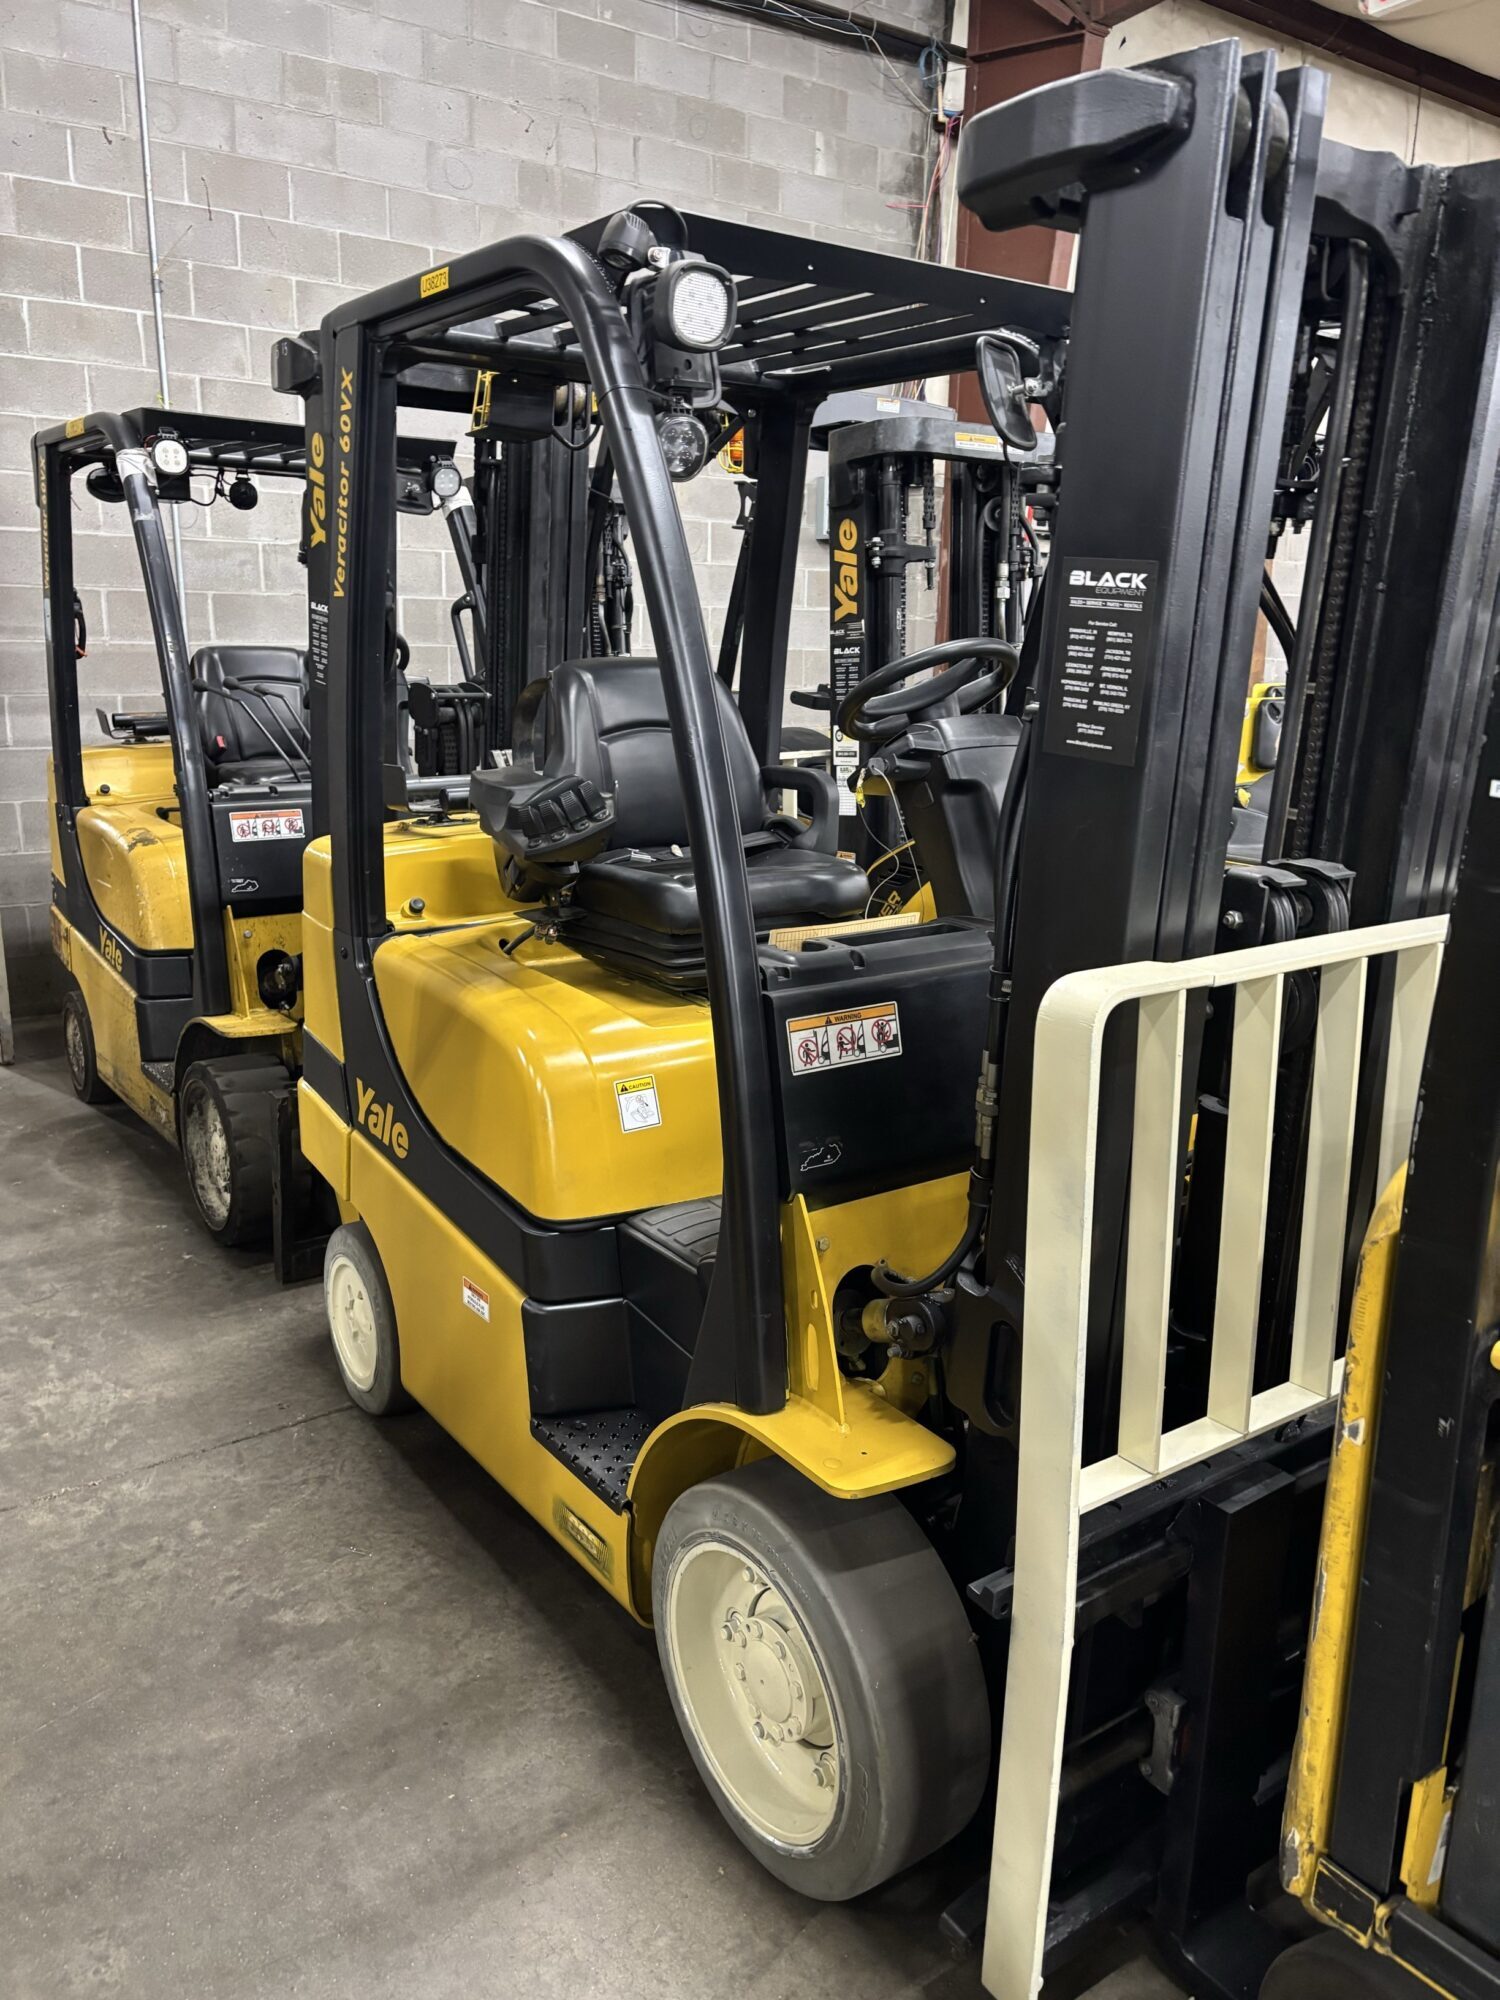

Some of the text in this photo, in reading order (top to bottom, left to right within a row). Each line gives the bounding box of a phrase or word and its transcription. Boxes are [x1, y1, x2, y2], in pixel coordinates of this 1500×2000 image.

[309, 432, 327, 548] Yale
[333, 366, 353, 598] Veracitor 60VX
[834, 518, 858, 622] Yale
[1069, 570, 1149, 589] BLACK
[1095, 587, 1147, 597] EQUIPMENT
[833, 647, 860, 655] BLACK
[99, 924, 123, 972] Yale
[833, 1012, 862, 1023] WARNING
[629, 1082, 651, 1090] CAUTION
[356, 1077, 409, 1159] Yale
